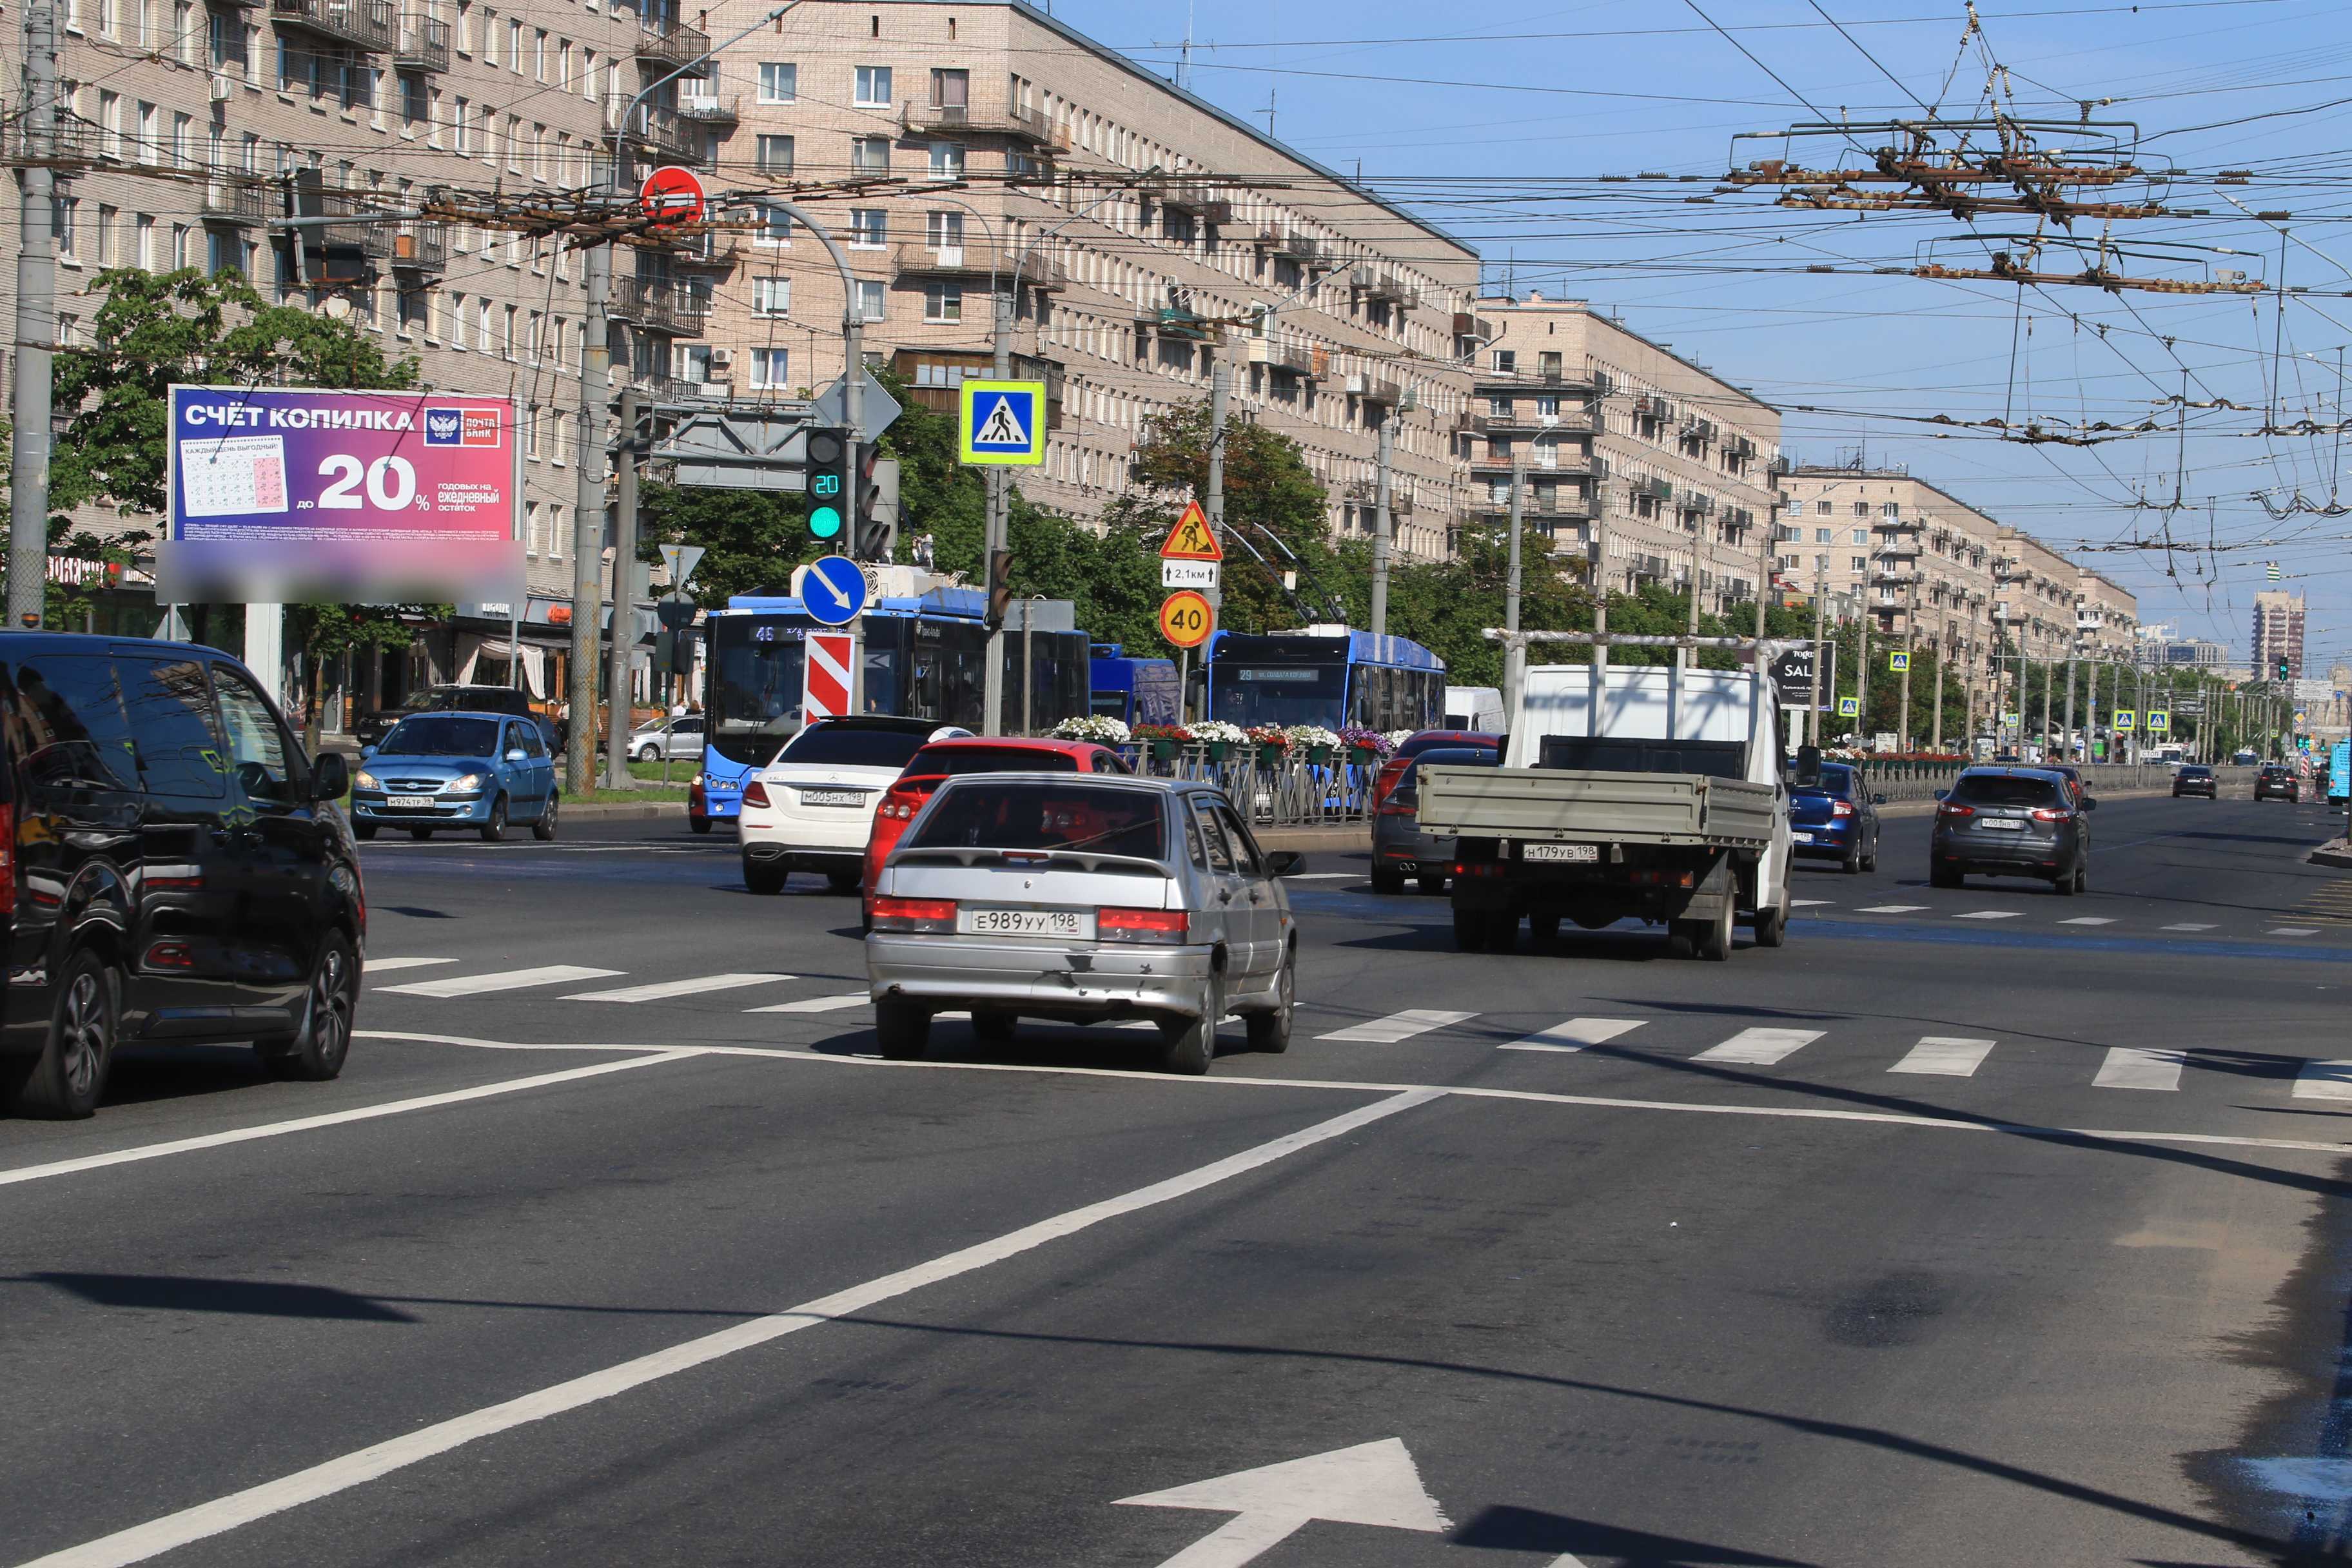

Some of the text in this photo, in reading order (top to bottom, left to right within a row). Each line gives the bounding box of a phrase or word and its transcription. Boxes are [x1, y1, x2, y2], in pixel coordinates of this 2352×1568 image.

[186, 402, 415, 431] СЧЁТ КОПИЛКА
[466, 418, 495, 427] ПОЧТА
[466, 429, 492, 438] БАНК
[816, 475, 839, 493] 20
[438, 489, 500, 504] ежедневный
[297, 501, 314, 509] до
[1170, 609, 1201, 630] 40
[1240, 670, 1251, 681] 29
[1577, 846, 1594, 854] 198
[1050, 914, 1075, 926] 198
